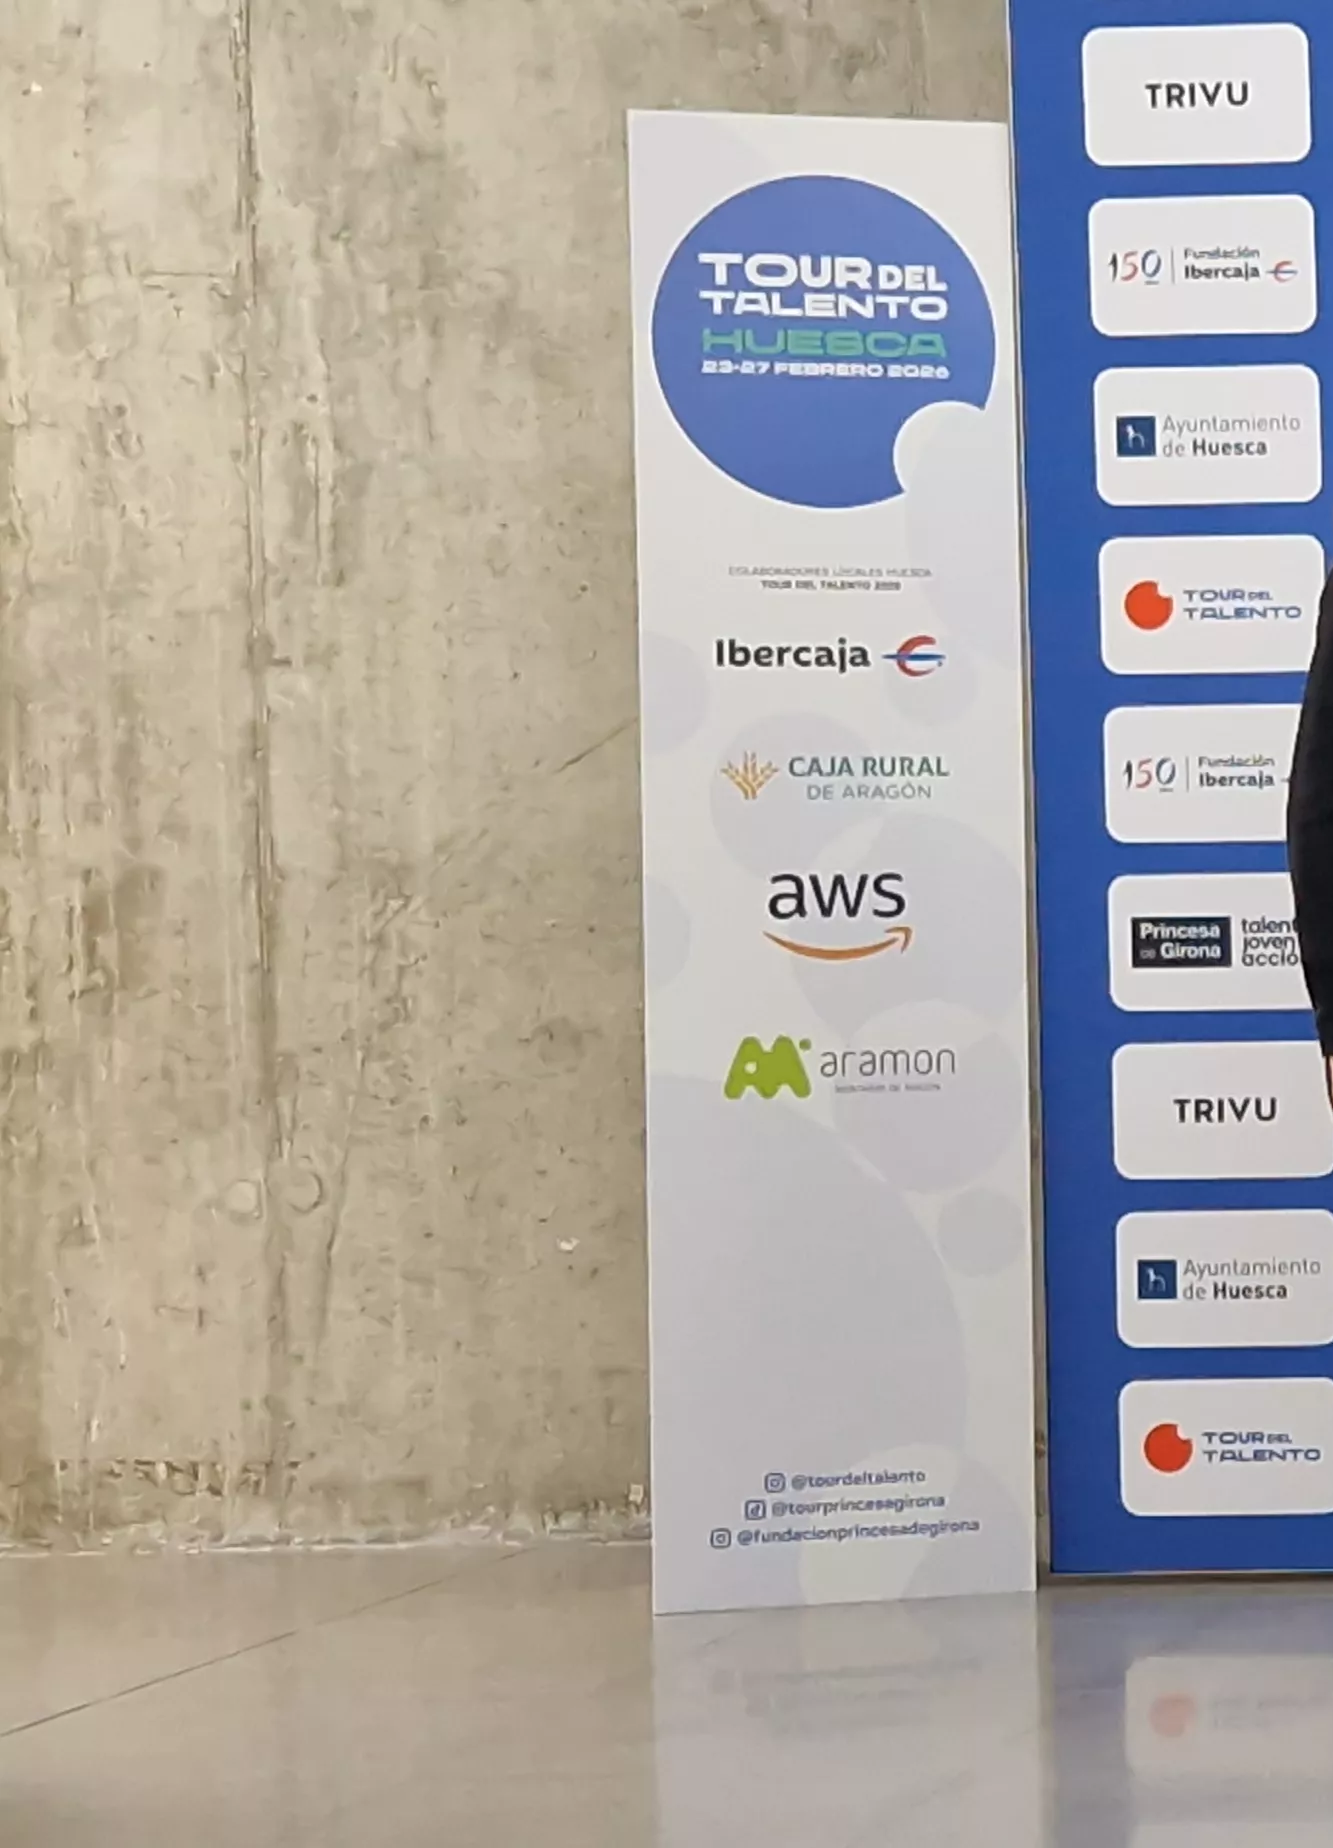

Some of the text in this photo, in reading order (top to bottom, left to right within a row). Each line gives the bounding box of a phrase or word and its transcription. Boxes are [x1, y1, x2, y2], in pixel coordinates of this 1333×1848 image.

[1146, 81, 1249, 108] TRIVU
[698, 253, 947, 291] TOUR DEL
[1108, 249, 1161, 283] 150
[1185, 262, 1260, 282] Ibercaja
[699, 291, 948, 320] TALENTO
[703, 328, 947, 358] HUESCA
[702, 361, 771, 374] 23-27
[774, 362, 883, 377] FEBRERO
[1163, 413, 1301, 438] Ayuntamiento
[1163, 438, 1267, 457] de Huesca
[1183, 589, 1245, 602] TOUR
[1183, 606, 1301, 620] TALENTO
[716, 638, 871, 673] Ibercaja
[788, 756, 950, 778] CAJA RURAL
[1122, 757, 1176, 789] 150
[1199, 770, 1275, 789] Ibercaja
[807, 782, 932, 800] DE ARAGÓN
[768, 872, 906, 920] aws
[1139, 922, 1220, 939] Princesa
[1161, 942, 1221, 959] Girona
[1242, 934, 1296, 953] joven
[820, 1049, 955, 1077] aramon
[1173, 1098, 1277, 1124] TRIVU
[1183, 1256, 1321, 1282] Ayuntamiento
[1183, 1281, 1287, 1300] de Huesca
[1202, 1431, 1264, 1445] TOUR
[1203, 1449, 1321, 1463] TALENTO
